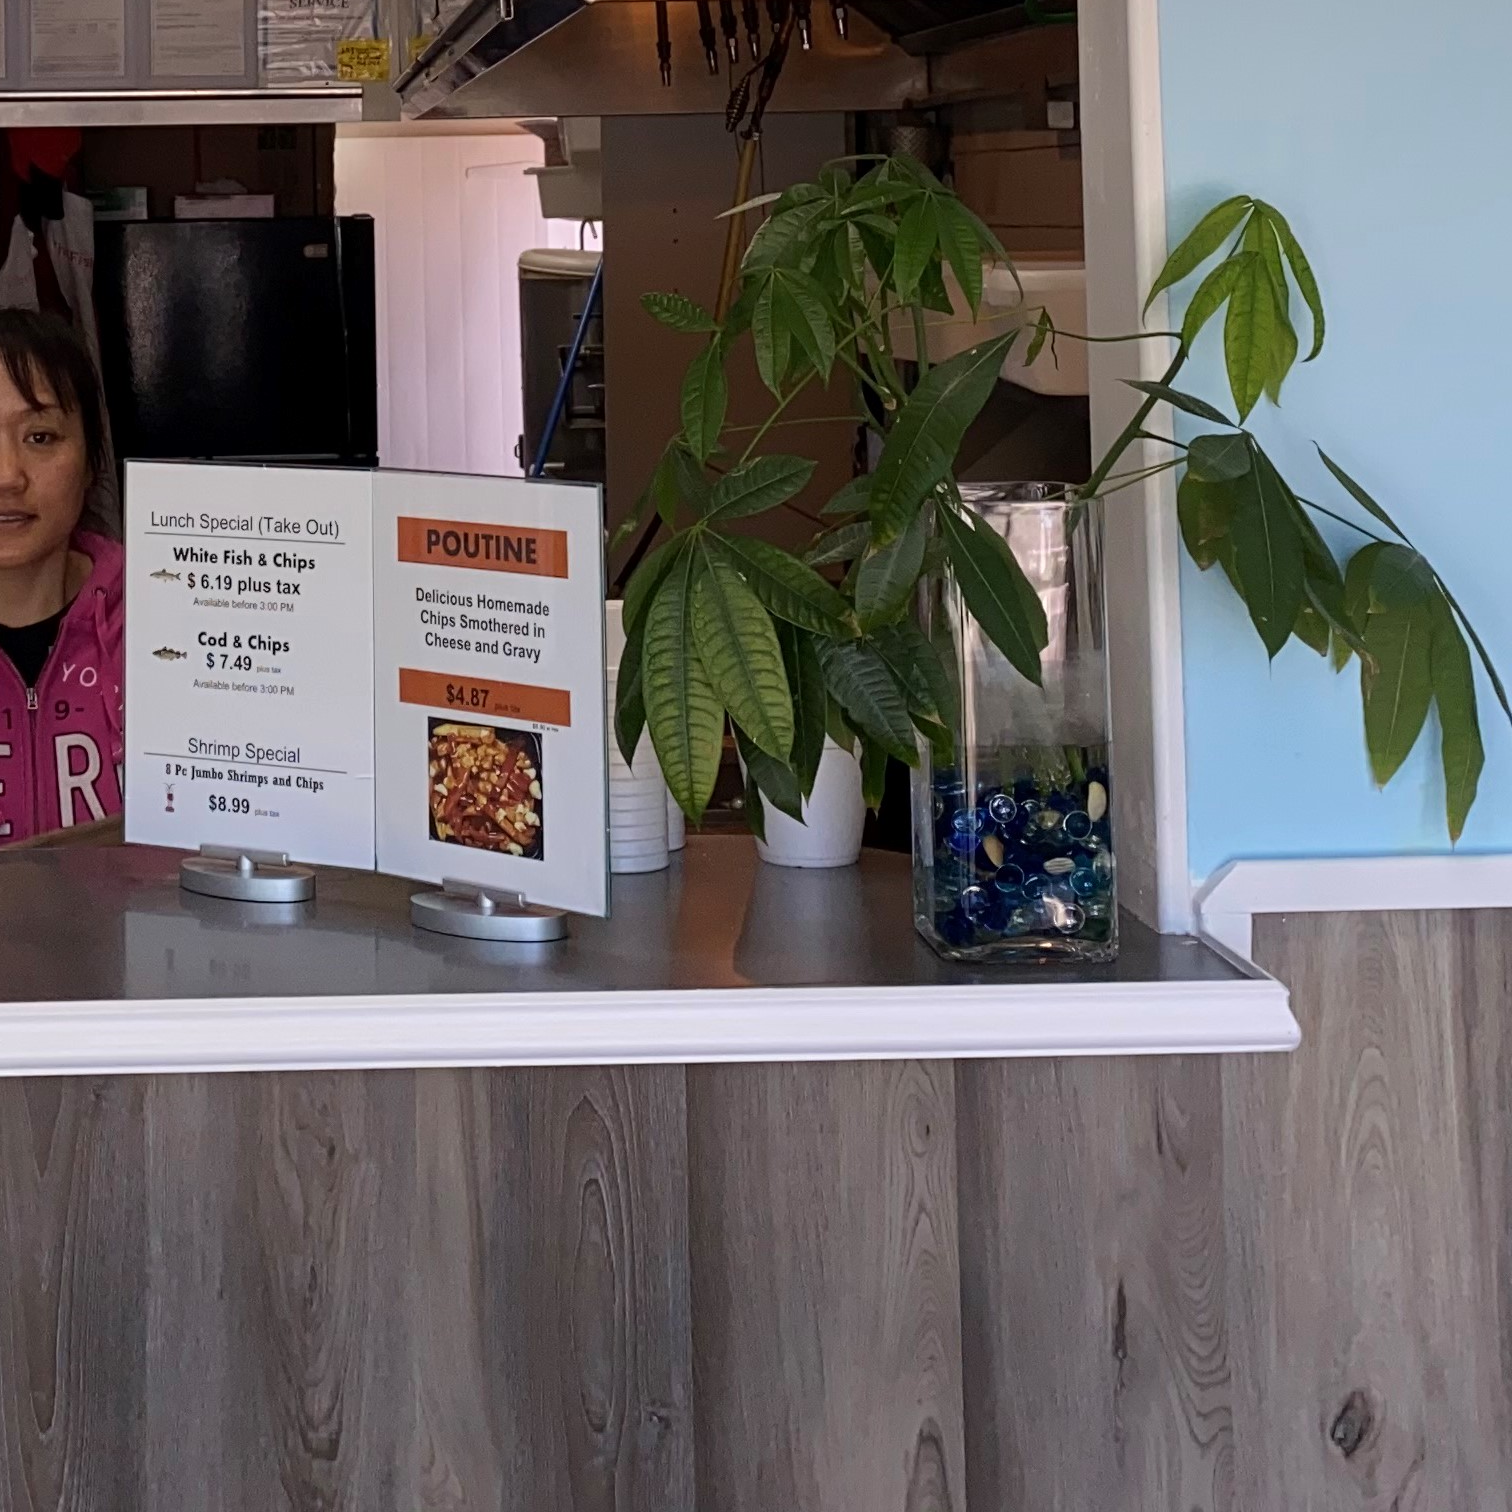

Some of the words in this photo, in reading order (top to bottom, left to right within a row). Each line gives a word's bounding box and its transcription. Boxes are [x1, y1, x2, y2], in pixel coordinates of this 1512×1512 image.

[151, 511, 195, 528] Lunch
[200, 513, 253, 533] Special
[258, 516, 301, 536] (Take
[306, 519, 339, 539] Out)
[173, 547, 218, 564] White
[223, 550, 252, 566] Fish
[258, 553, 267, 567] &
[273, 553, 315, 573] Chips
[426, 529, 537, 565] POUTINE
[187, 572, 195, 590] $
[201, 574, 232, 591] 6.19
[237, 576, 271, 595] plus
[277, 580, 301, 595] tax
[193, 597, 230, 609] Available
[280, 603, 294, 612] PM
[416, 587, 472, 607] Delicious
[477, 594, 550, 616] Homemade
[421, 610, 455, 630] Chips
[460, 614, 529, 637] Smothered
[534, 623, 545, 638] in
[198, 631, 227, 648] Cod
[233, 635, 242, 648] &
[248, 634, 290, 655] Chips
[425, 632, 471, 651] Cheese
[475, 640, 498, 655] and
[503, 642, 541, 664] Gravy
[206, 652, 214, 670] $
[220, 654, 252, 671] 7.49
[193, 679, 230, 690] Available
[280, 686, 294, 696] PM
[446, 683, 489, 708] $4.87
[188, 737, 240, 759] Shrimp
[245, 743, 300, 764] Special
[175, 764, 187, 776] Pc
[191, 766, 224, 780] Jumbo
[227, 769, 268, 787] Shrimps
[273, 775, 291, 787] and
[296, 777, 324, 793] Chips
[208, 794, 250, 814] $8.99
